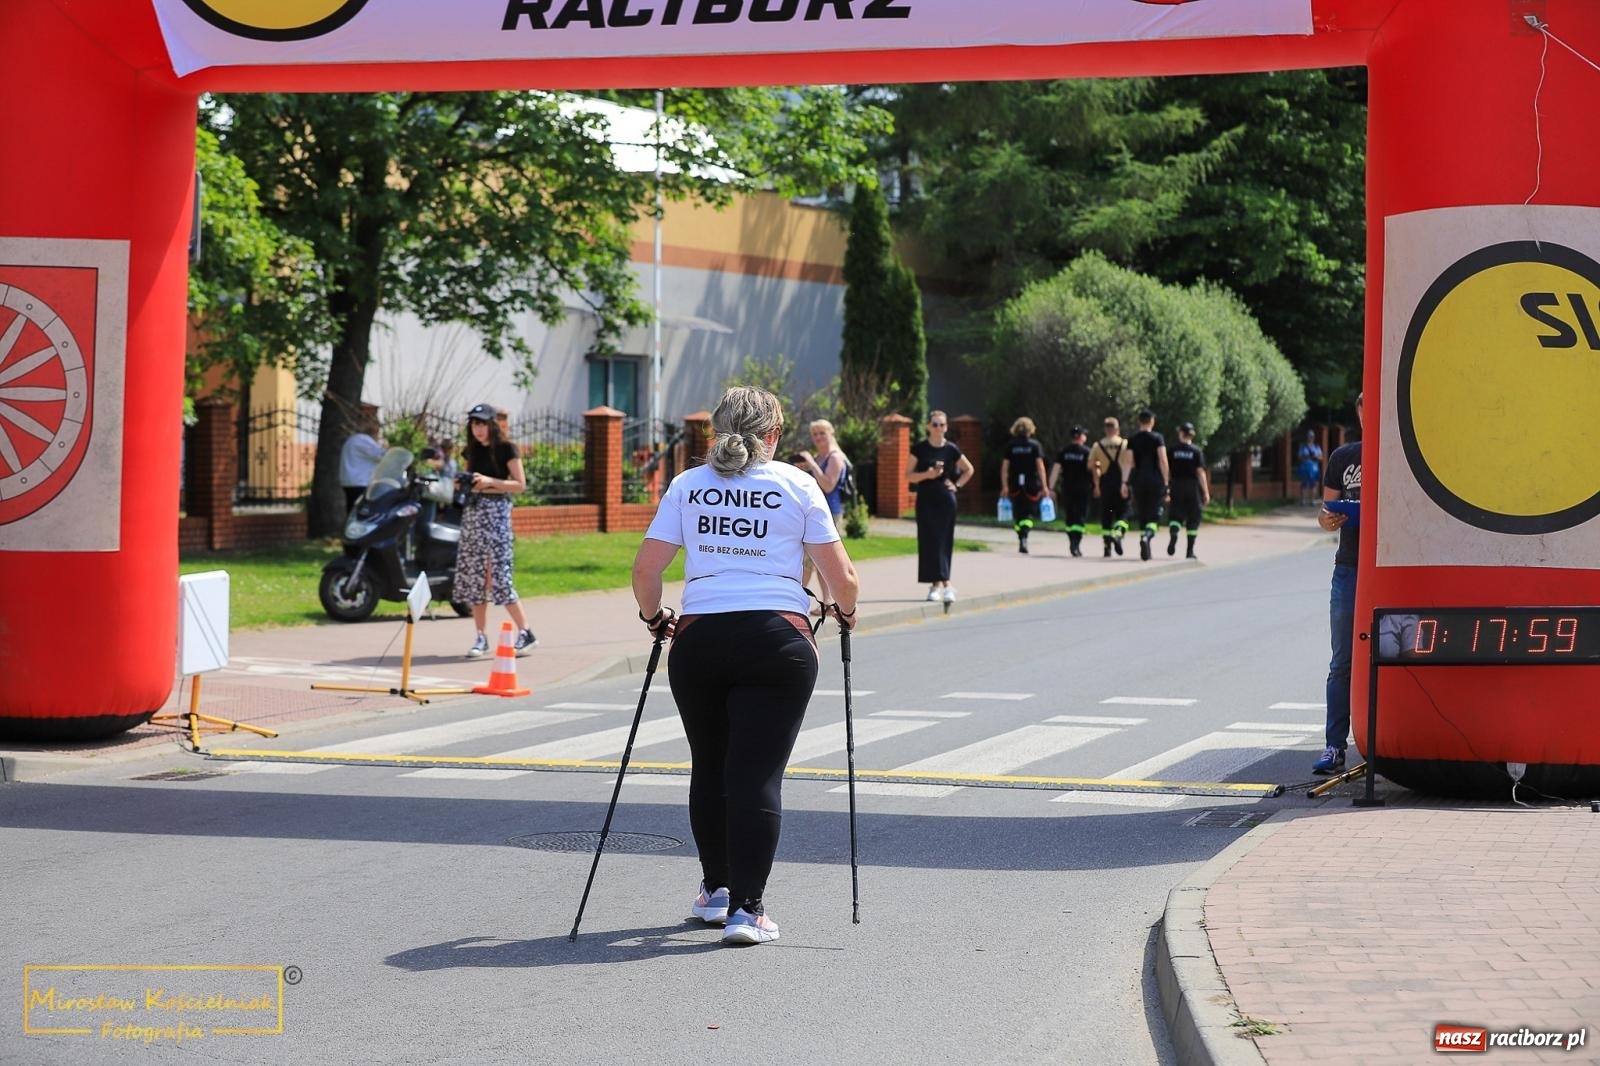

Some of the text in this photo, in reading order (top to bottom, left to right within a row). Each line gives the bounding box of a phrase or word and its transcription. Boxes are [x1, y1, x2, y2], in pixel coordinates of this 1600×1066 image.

[688, 488, 783, 510] KONIEC
[698, 515, 769, 539] BIEGU
[698, 544, 767, 557] BIEG BEZ GRANIC
